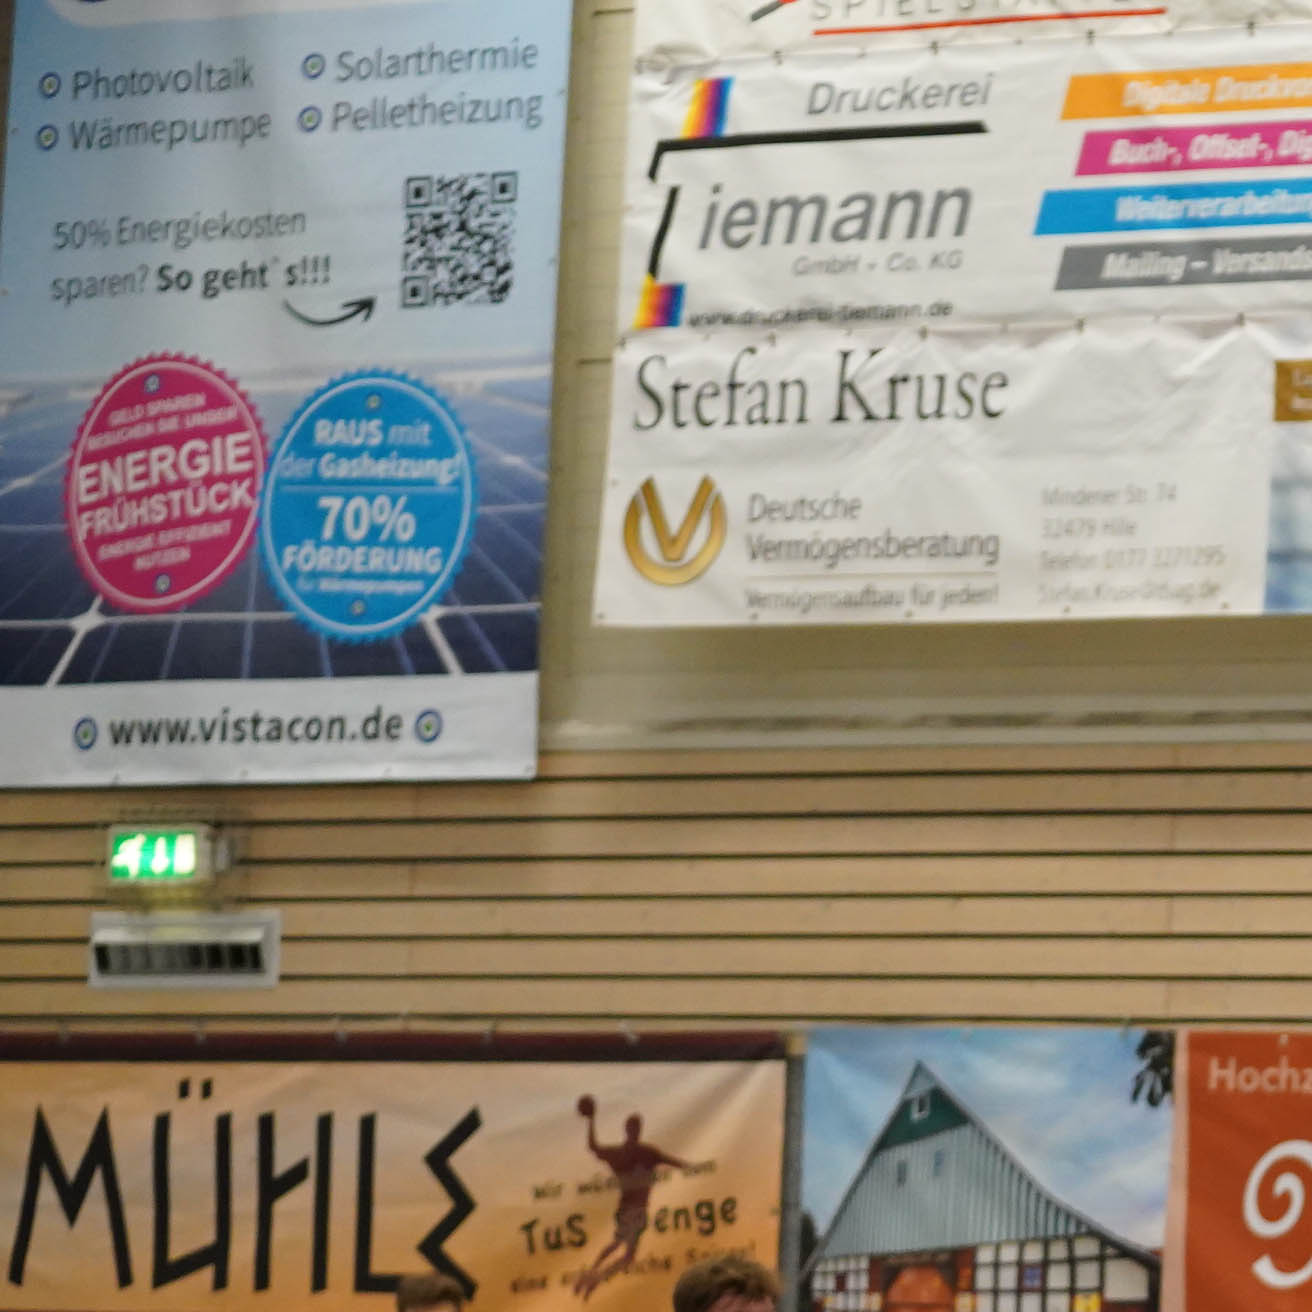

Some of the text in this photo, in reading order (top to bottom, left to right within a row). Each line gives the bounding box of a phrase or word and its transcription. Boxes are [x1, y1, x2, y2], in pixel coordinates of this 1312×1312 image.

[72, 59, 255, 101] Photovoltaik
[337, 38, 539, 82] Solarthermie
[331, 92, 544, 133] Pelletheizung
[806, 73, 996, 116] Druckerei
[69, 109, 273, 152] Wärmepumpe
[53, 209, 307, 250] 50% Energiekosten
[50, 264, 150, 306] sparen?
[156, 263, 193, 293] So
[632, 346, 1010, 432] Stefan Kruse
[314, 418, 384, 446] RAUS
[78, 429, 254, 505] ENERGIE
[78, 477, 256, 543] FRÜHSTÜCK
[316, 494, 417, 543] 70%
[748, 490, 863, 524] Deutsche
[281, 538, 443, 574] FÖRDERUNG
[746, 528, 1001, 569] Vermögensberatung
[108, 705, 404, 747] www.vistacon.de
[8, 1077, 482, 1300] MÜHLE
[519, 1213, 588, 1255] TuS
